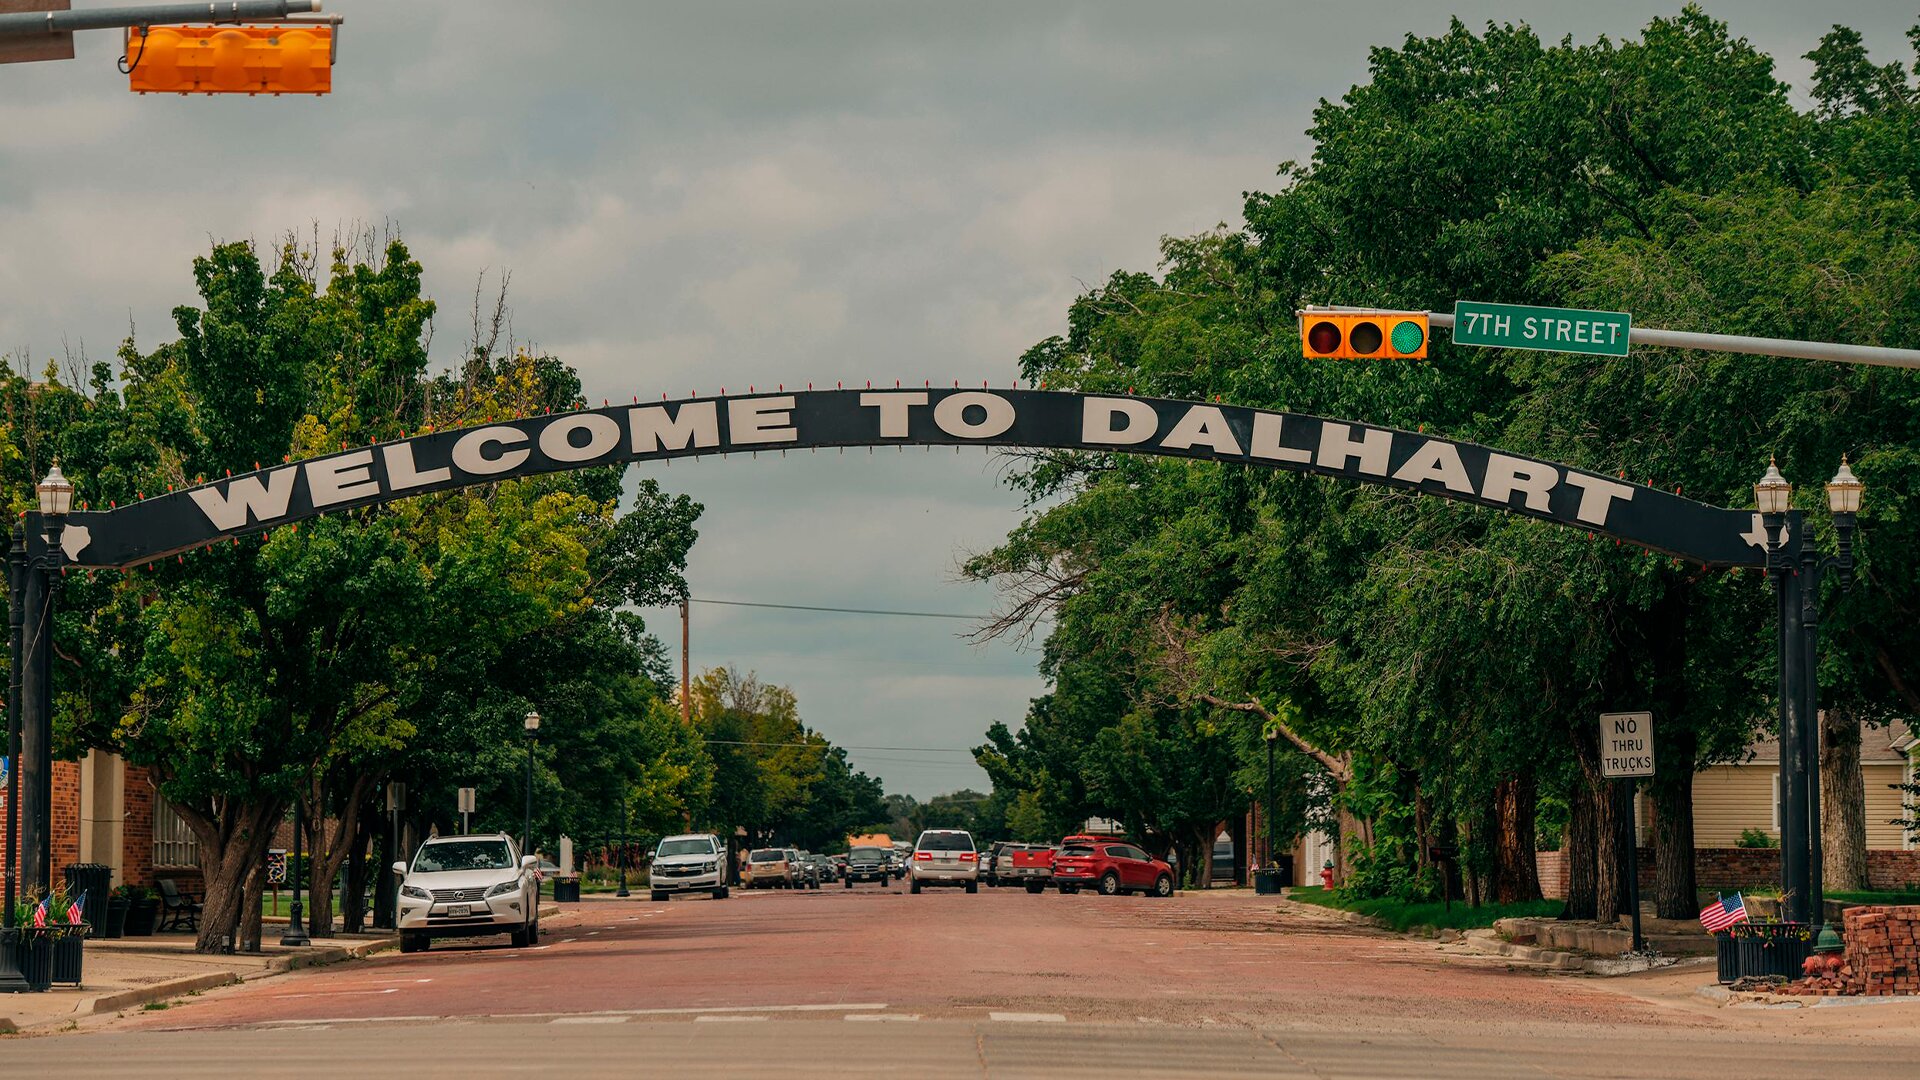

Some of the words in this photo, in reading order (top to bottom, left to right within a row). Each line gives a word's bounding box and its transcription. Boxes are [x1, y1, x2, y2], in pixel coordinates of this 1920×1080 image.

[1464, 312, 1511, 337] 7TH
[1523, 317, 1621, 345] STREET
[188, 395, 799, 531] WELCOME
[859, 391, 1016, 439] TO
[1081, 396, 1635, 526] DALHART
[1615, 719, 1637, 734] NO
[1612, 739, 1643, 752] THRU
[1605, 756, 1651, 769] TRUCKS
